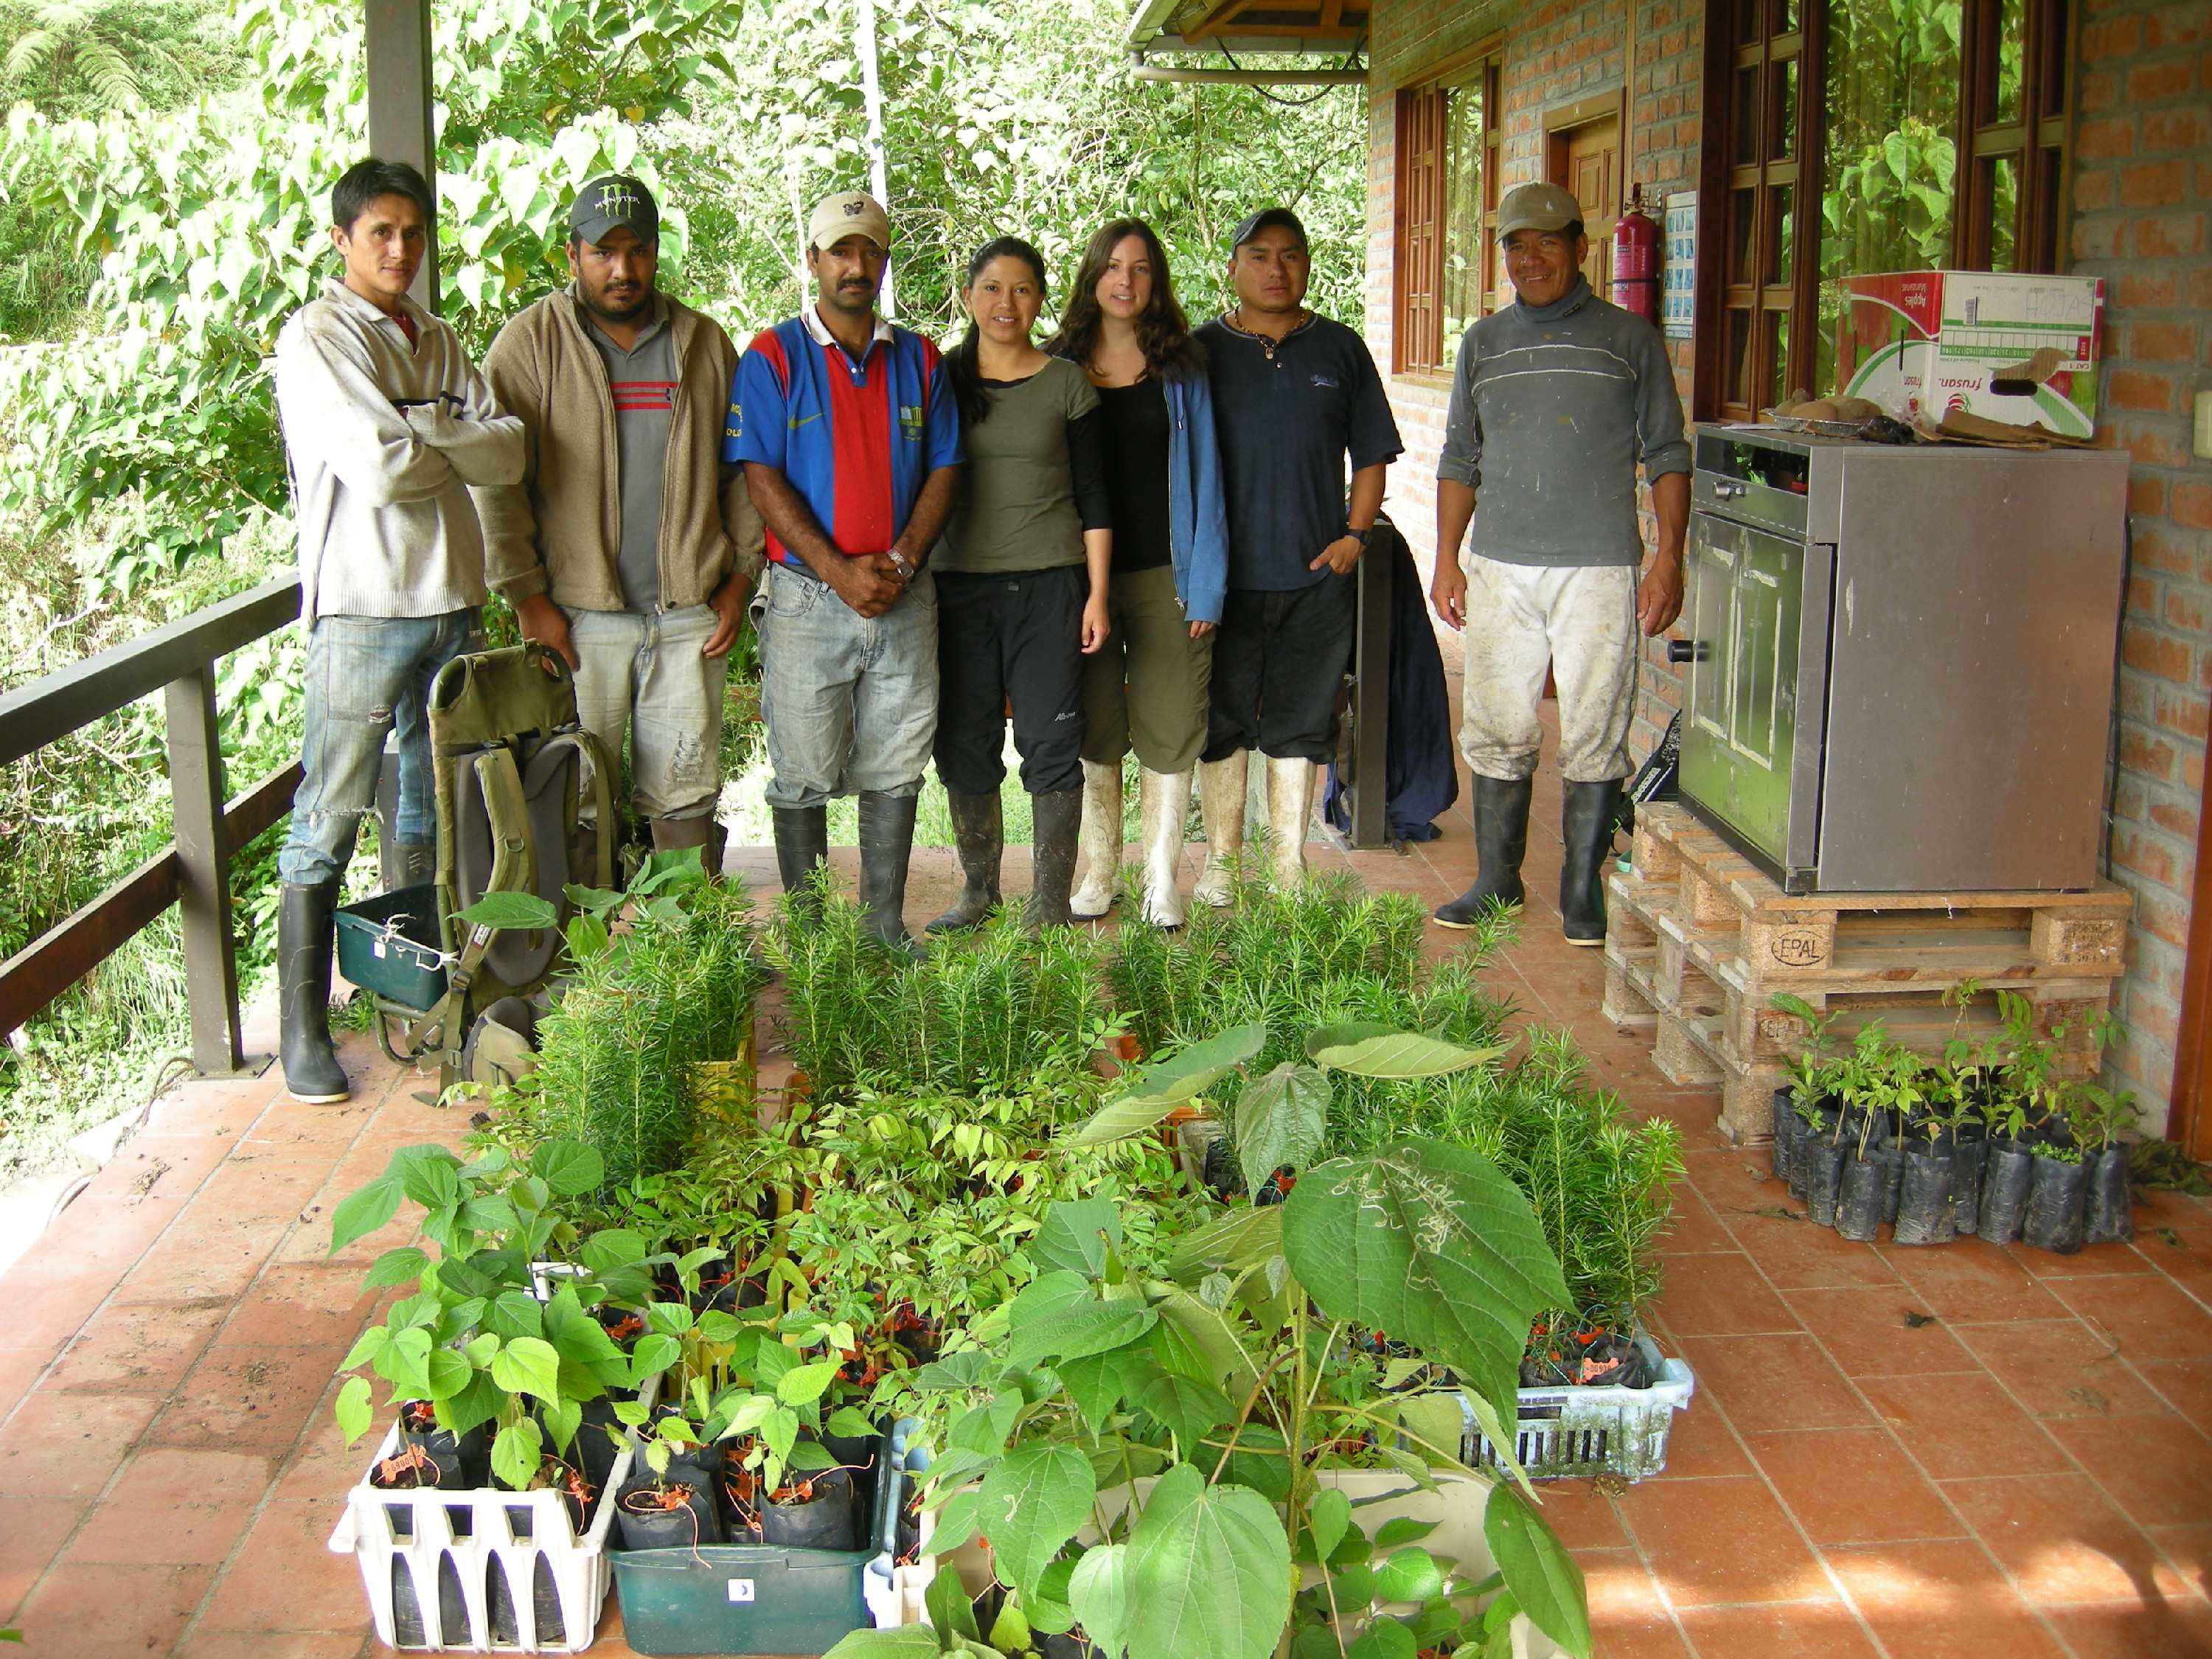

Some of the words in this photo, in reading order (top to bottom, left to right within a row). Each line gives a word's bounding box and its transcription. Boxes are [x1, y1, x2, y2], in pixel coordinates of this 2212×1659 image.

[1902, 283, 1927, 293] Manzanas
[1905, 293, 1926, 309] Apples
[2025, 291, 2093, 320] HOJAS
[1781, 939, 1819, 958] EPAL
